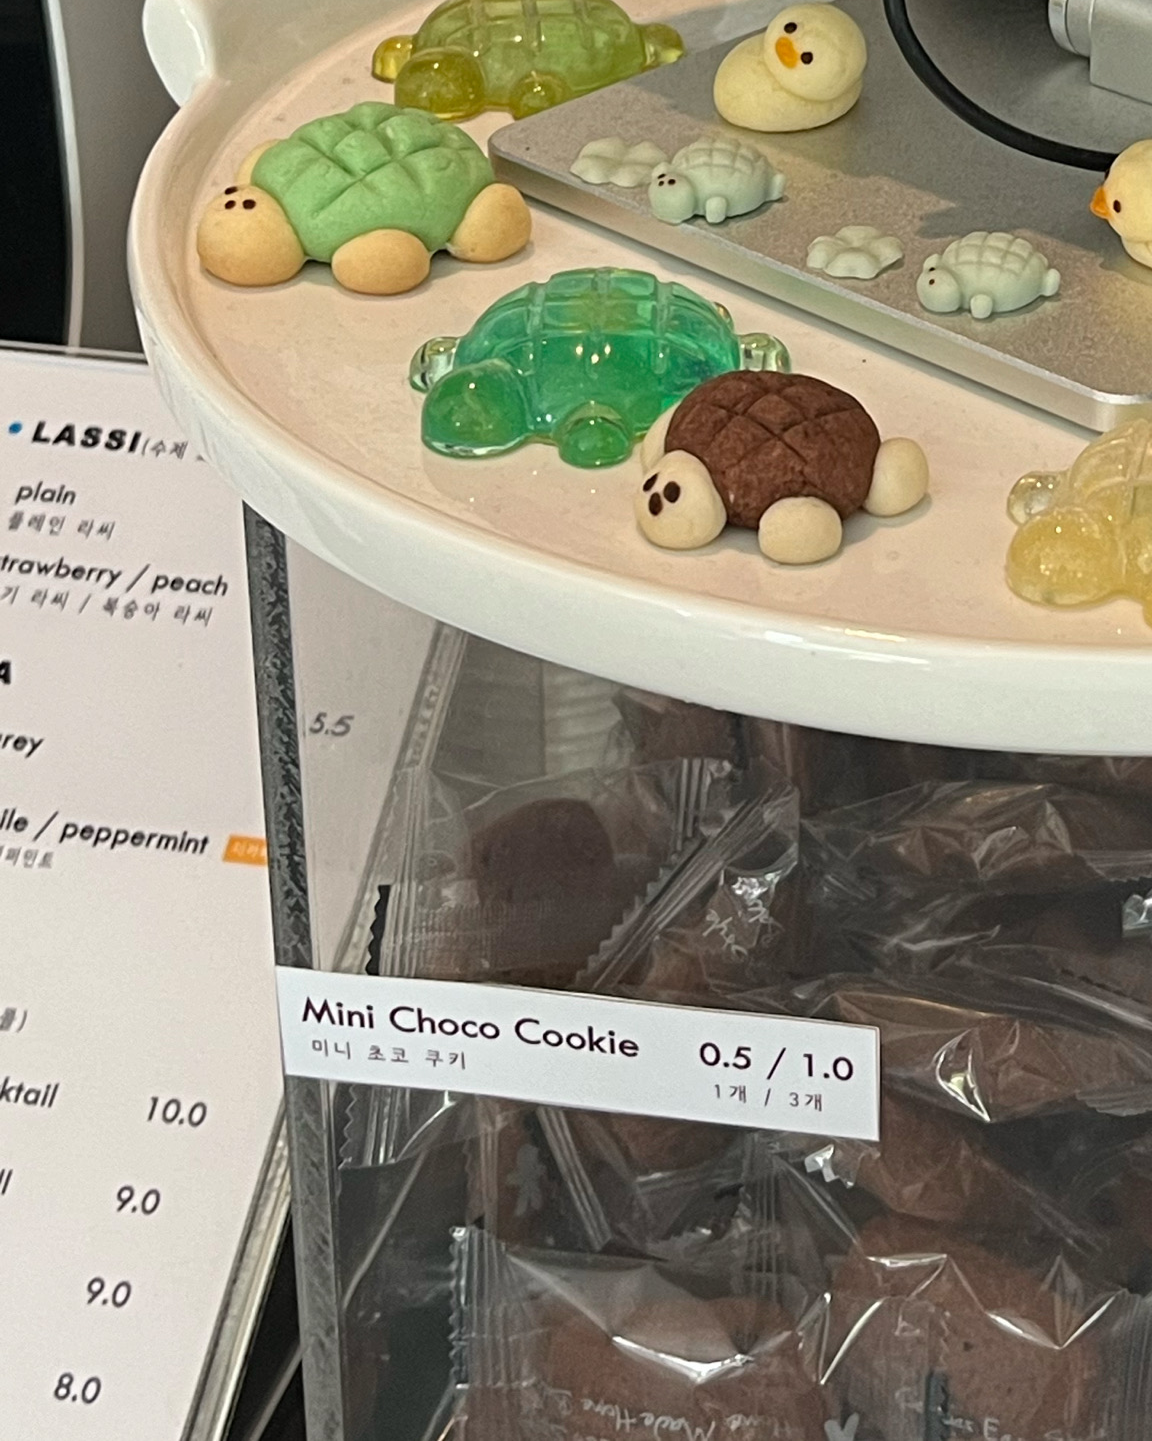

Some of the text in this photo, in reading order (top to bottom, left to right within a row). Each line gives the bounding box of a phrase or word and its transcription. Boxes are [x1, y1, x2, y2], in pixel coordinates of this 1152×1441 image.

[15, 480, 77, 506] plain
[8, 510, 116, 541] 플레인 라씨
[0, 553, 123, 590] trawberry
[151, 574, 229, 598] peach
[31, 588, 69, 611] 라씨
[103, 596, 160, 622] 복숭아
[173, 604, 214, 628] 라씨
[309, 712, 355, 737] 5.5
[59, 821, 209, 855] peppermint
[301, 996, 855, 1083] Mini Choco Cookie 0.5 / 1.0
[311, 1039, 352, 1062] 미니
[367, 1044, 410, 1065] 초코
[424, 1049, 467, 1071] 쿠키
[146, 1096, 208, 1128] 10.0
[115, 1185, 162, 1216] 9.0
[85, 1276, 133, 1309] 9.0
[53, 1372, 102, 1404] 8.0
